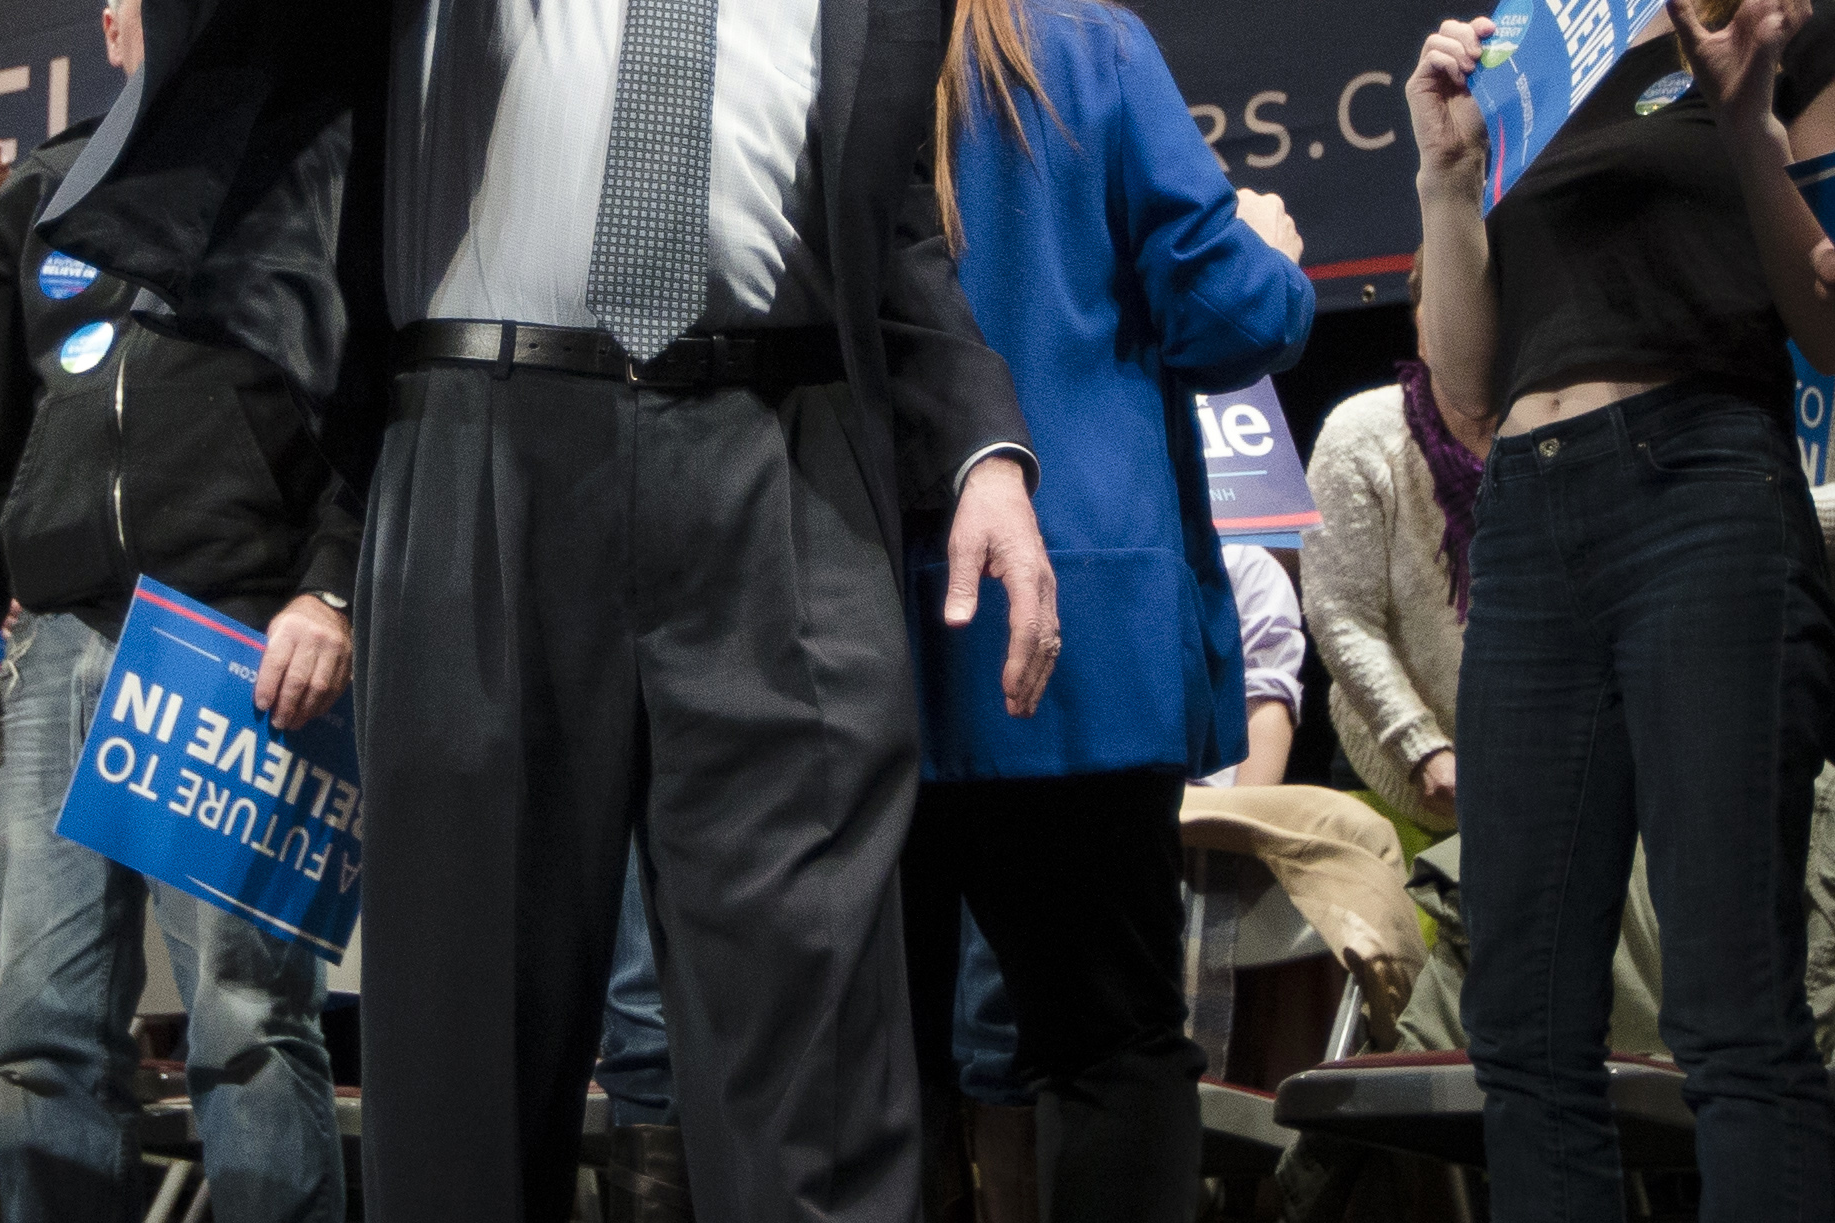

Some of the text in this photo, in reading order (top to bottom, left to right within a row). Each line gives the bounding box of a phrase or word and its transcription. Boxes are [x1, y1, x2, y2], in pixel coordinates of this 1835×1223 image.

[111, 670, 184, 744] IN
[95, 735, 363, 895] A FUTURE TO
